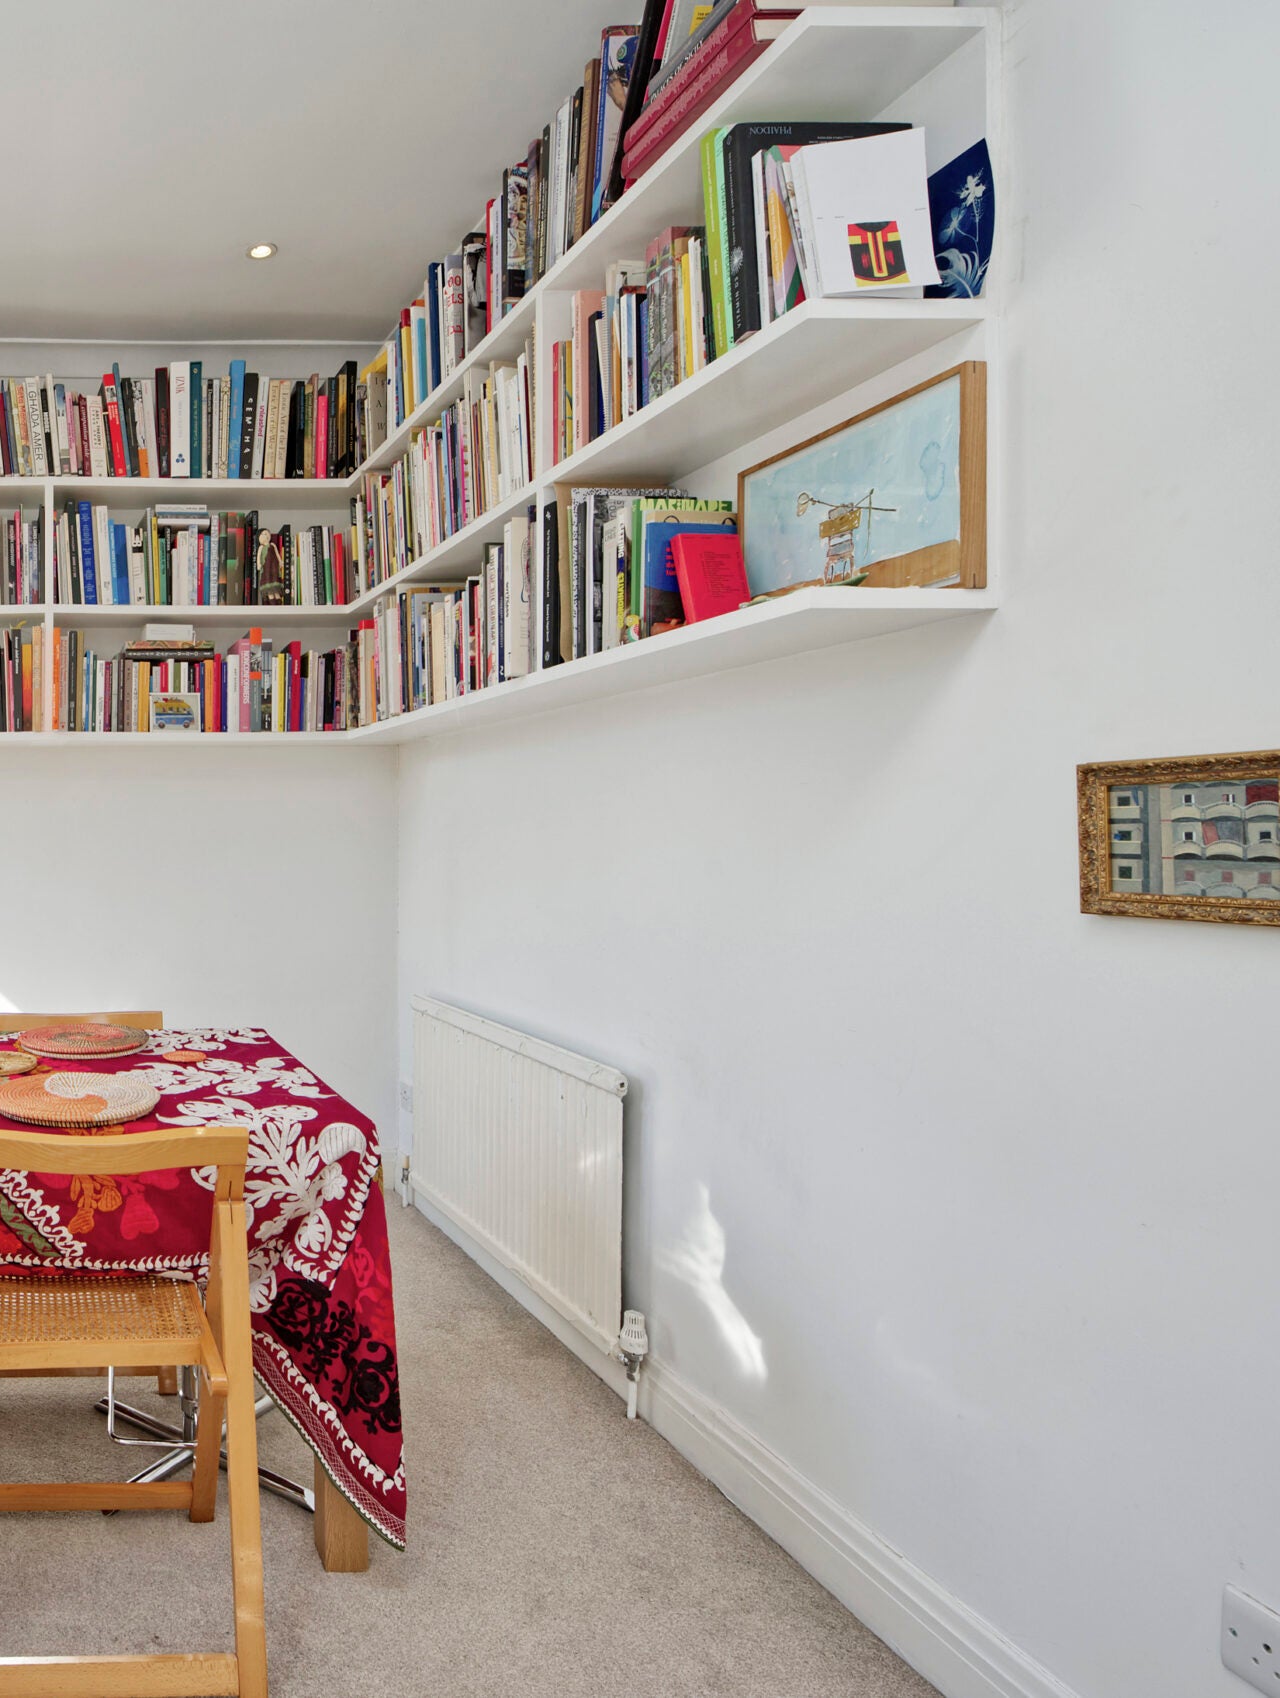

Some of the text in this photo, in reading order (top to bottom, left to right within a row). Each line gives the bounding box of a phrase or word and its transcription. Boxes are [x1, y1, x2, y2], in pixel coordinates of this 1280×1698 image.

[749, 126, 792, 136] PHAIDON
[175, 376, 185, 394] IZNIK
[28, 390, 43, 460] GHADA AMER
[80, 406, 88, 440] companion
[257, 404, 265, 437] unleashed
[242, 650, 250, 704] NONCONFORMERS
